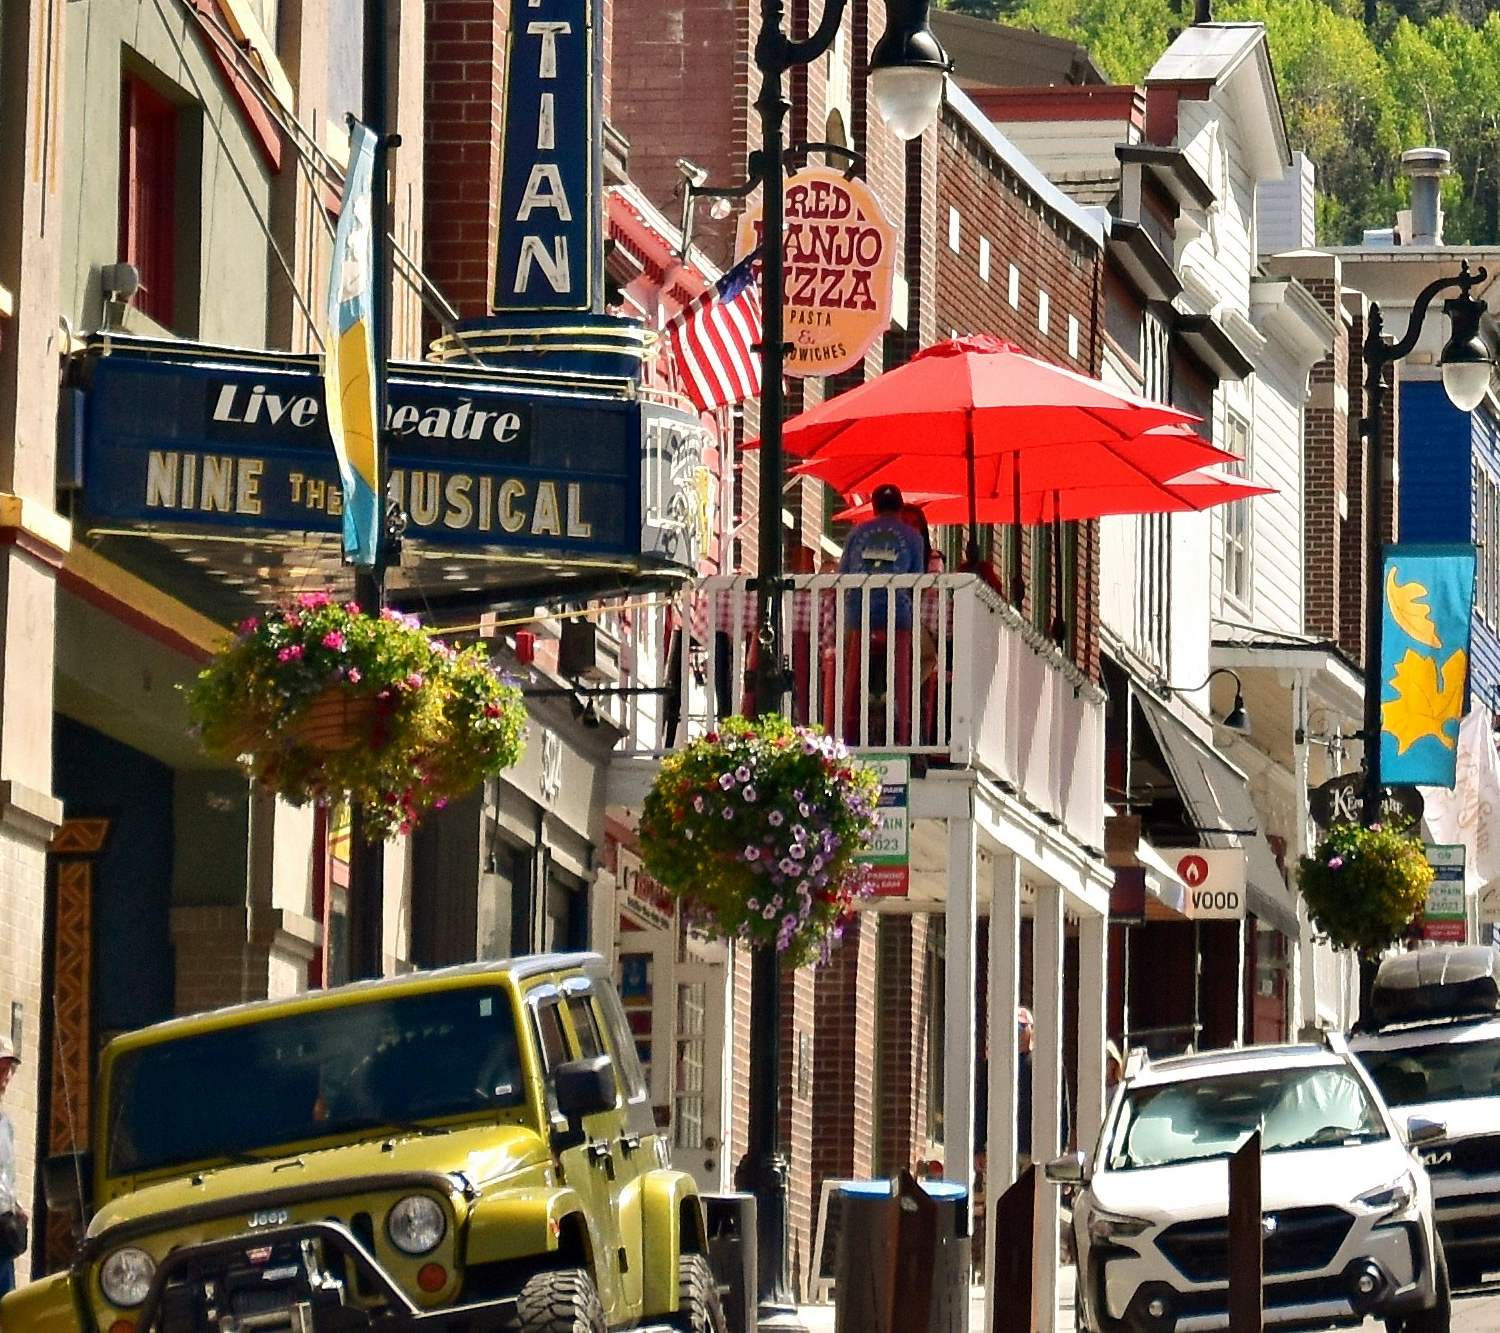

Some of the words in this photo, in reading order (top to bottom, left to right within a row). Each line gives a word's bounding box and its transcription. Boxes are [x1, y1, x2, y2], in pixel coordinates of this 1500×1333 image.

[785, 180, 851, 220] RED
[754, 221, 882, 267] ANJO
[753, 263, 877, 310] IZZA
[790, 309, 832, 326] PASTA
[785, 342, 847, 362] DWICHES
[798, 329, 815, 345] &
[212, 384, 319, 427] Live
[386, 397, 521, 445] eatre
[146, 450, 266, 515] NINE
[289, 472, 343, 517] THE
[882, 818, 903, 830] AIN
[247, 1211, 288, 1228] Jeep
